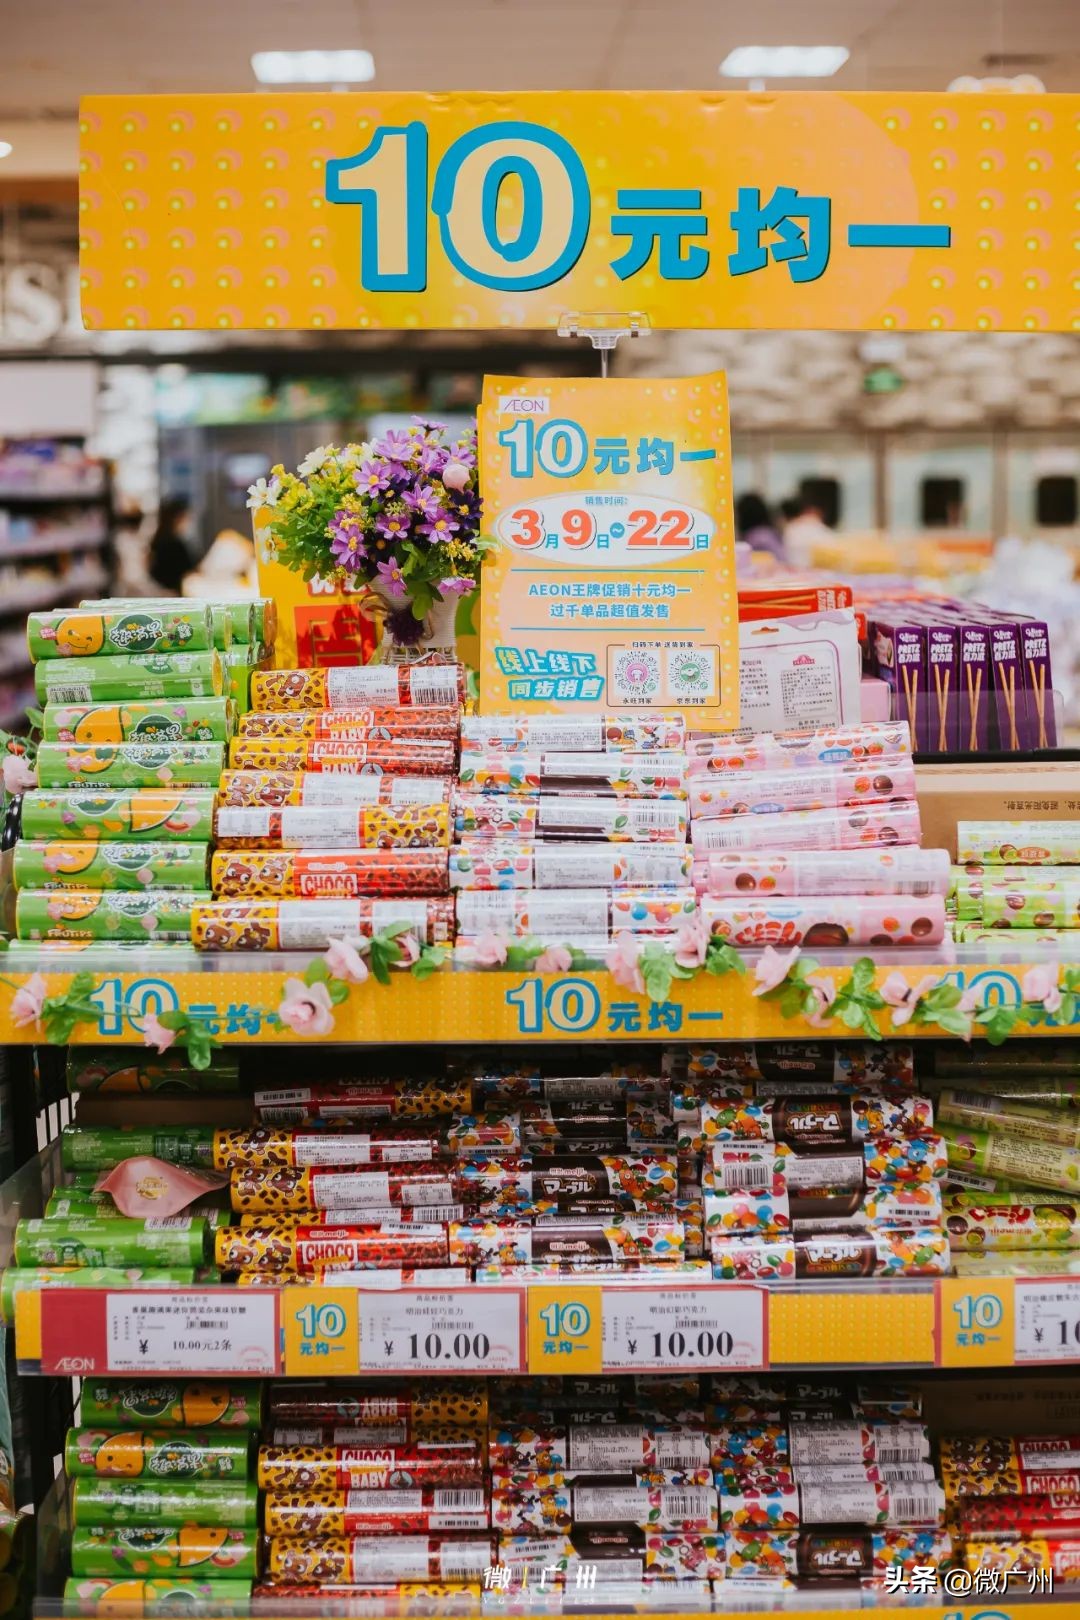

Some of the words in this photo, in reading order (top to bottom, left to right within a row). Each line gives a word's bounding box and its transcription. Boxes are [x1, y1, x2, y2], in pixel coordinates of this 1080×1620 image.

[325, 120, 953, 293] 10元均一
[499, 418, 717, 479] 10元均一
[528, 583, 691, 598] AEON王牌促销十元均一
[550, 603, 670, 618] 过千单品超值发售
[496, 648, 597, 675] 线上线下
[508, 675, 605, 701] 同步销售
[506, 977, 723, 1033] 10元均一
[305, 1243, 354, 1262] CHOCO
[296, 1303, 346, 1338] 10
[540, 1302, 590, 1337] 10
[953, 1294, 1003, 1329] 10
[408, 1332, 491, 1360] 10.00
[653, 1330, 734, 1358] 10.00
[350, 1470, 388, 1488] BABY
